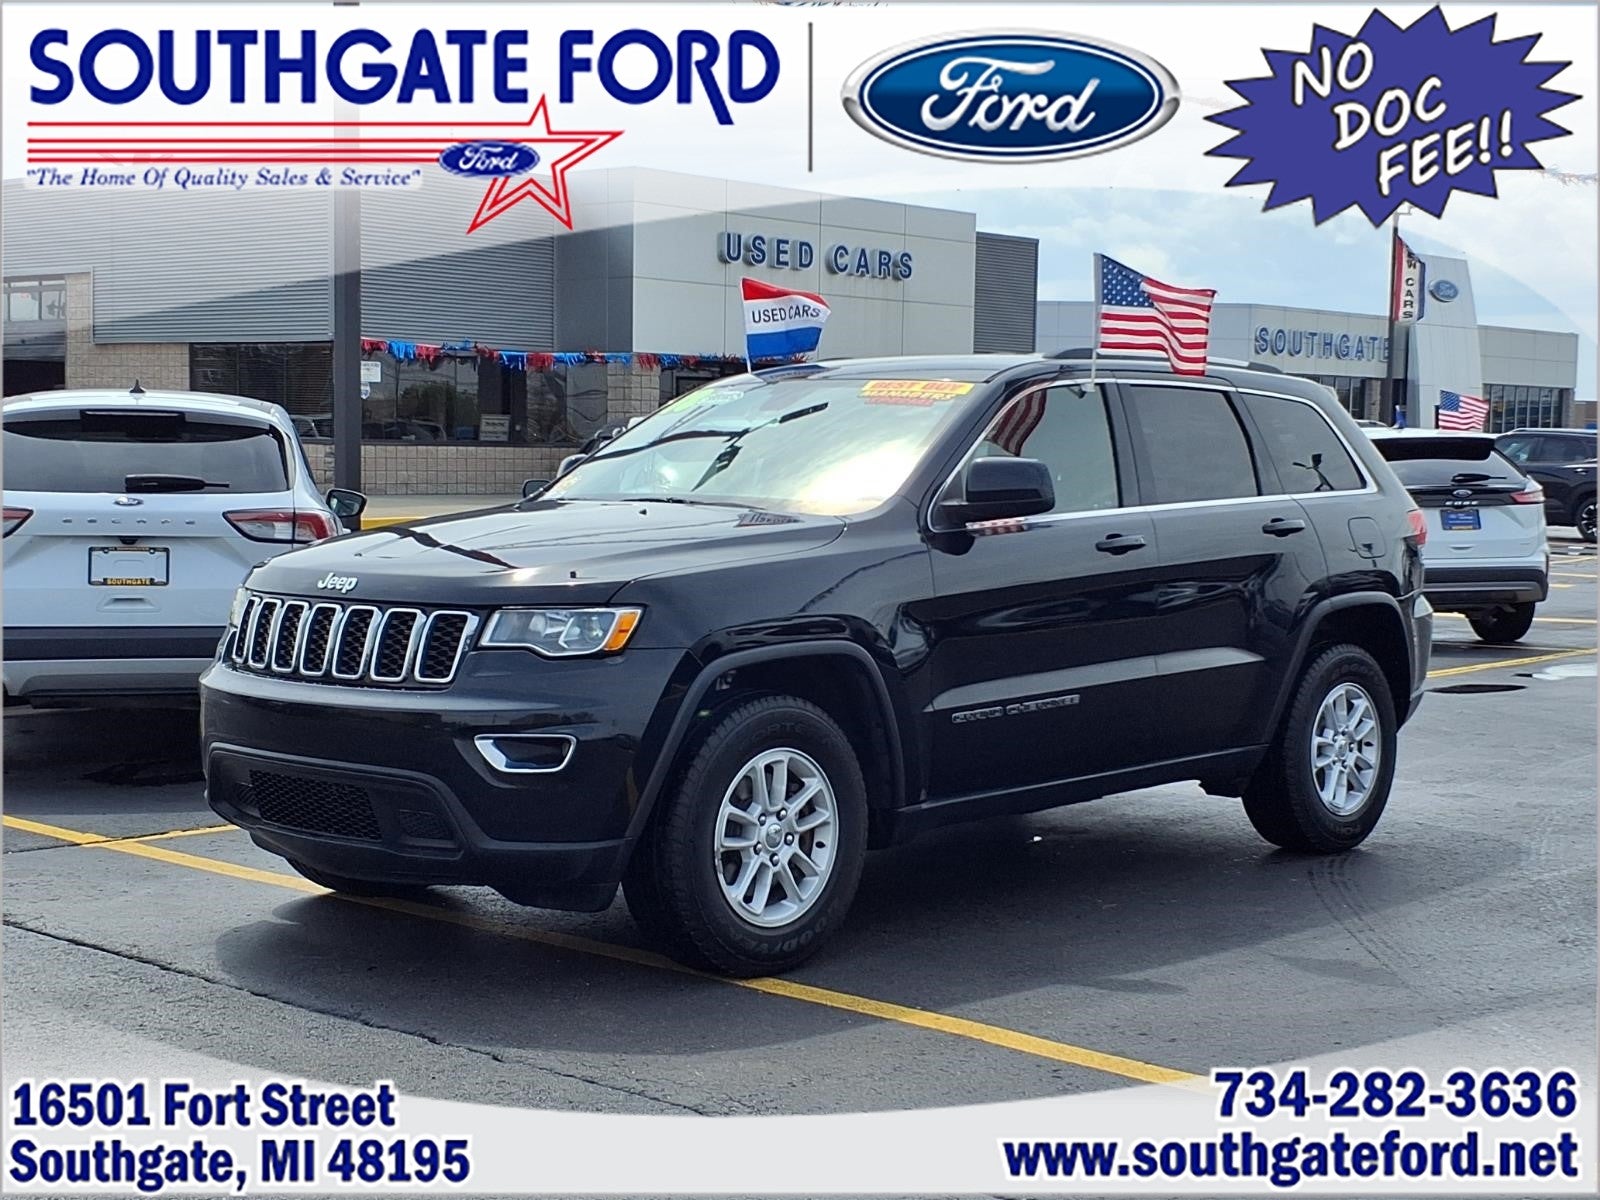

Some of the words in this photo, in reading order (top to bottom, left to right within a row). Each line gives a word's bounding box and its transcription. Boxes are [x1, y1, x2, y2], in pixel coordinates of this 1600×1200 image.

[722, 232, 815, 270] USED
[829, 245, 914, 280] CARS
[752, 308, 787, 323] USED
[788, 304, 821, 320] CARS
[1403, 277, 1415, 319] CARS
[1256, 326, 1390, 362] SOUTHGATE
[317, 572, 358, 594] Jeep
